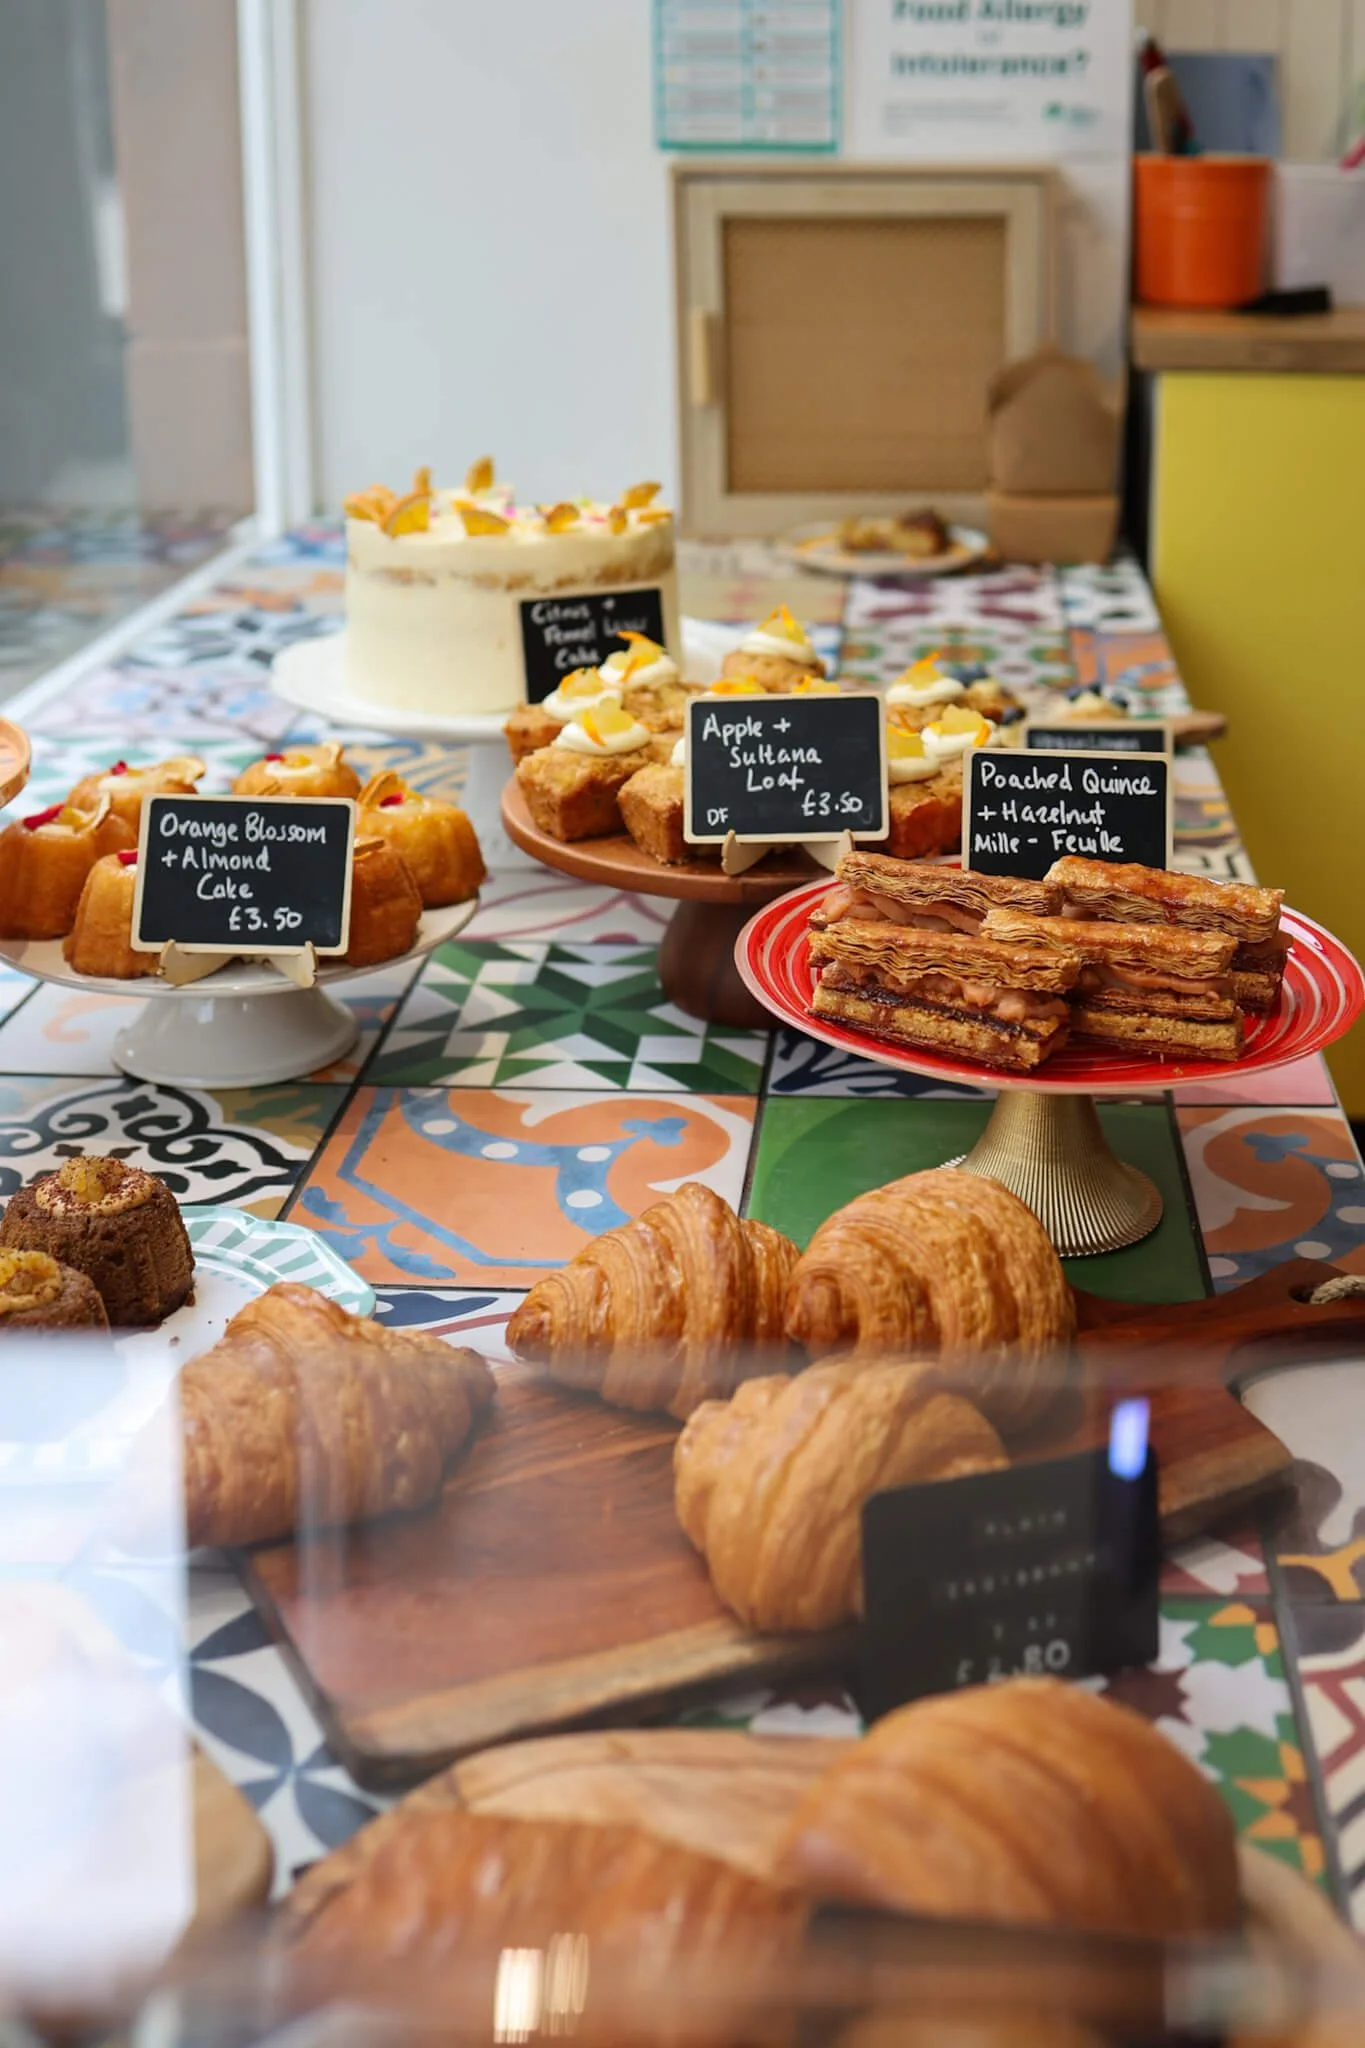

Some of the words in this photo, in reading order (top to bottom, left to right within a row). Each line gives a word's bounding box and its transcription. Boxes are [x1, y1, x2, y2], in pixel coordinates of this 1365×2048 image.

[554, 647, 601, 669] Cake
[702, 713, 763, 746] Apple
[773, 718, 791, 732] +
[730, 742, 822, 768] Sultana
[747, 766, 808, 793] Loaf
[981, 761, 1072, 791] Poached
[1083, 766, 1157, 795] Quince
[801, 789, 863, 816] £3.50
[160, 813, 238, 846] Orange
[245, 812, 326, 844] Blossom
[707, 808, 728, 826] DF
[197, 873, 253, 900] Cake
[229, 906, 302, 931] £3.50
